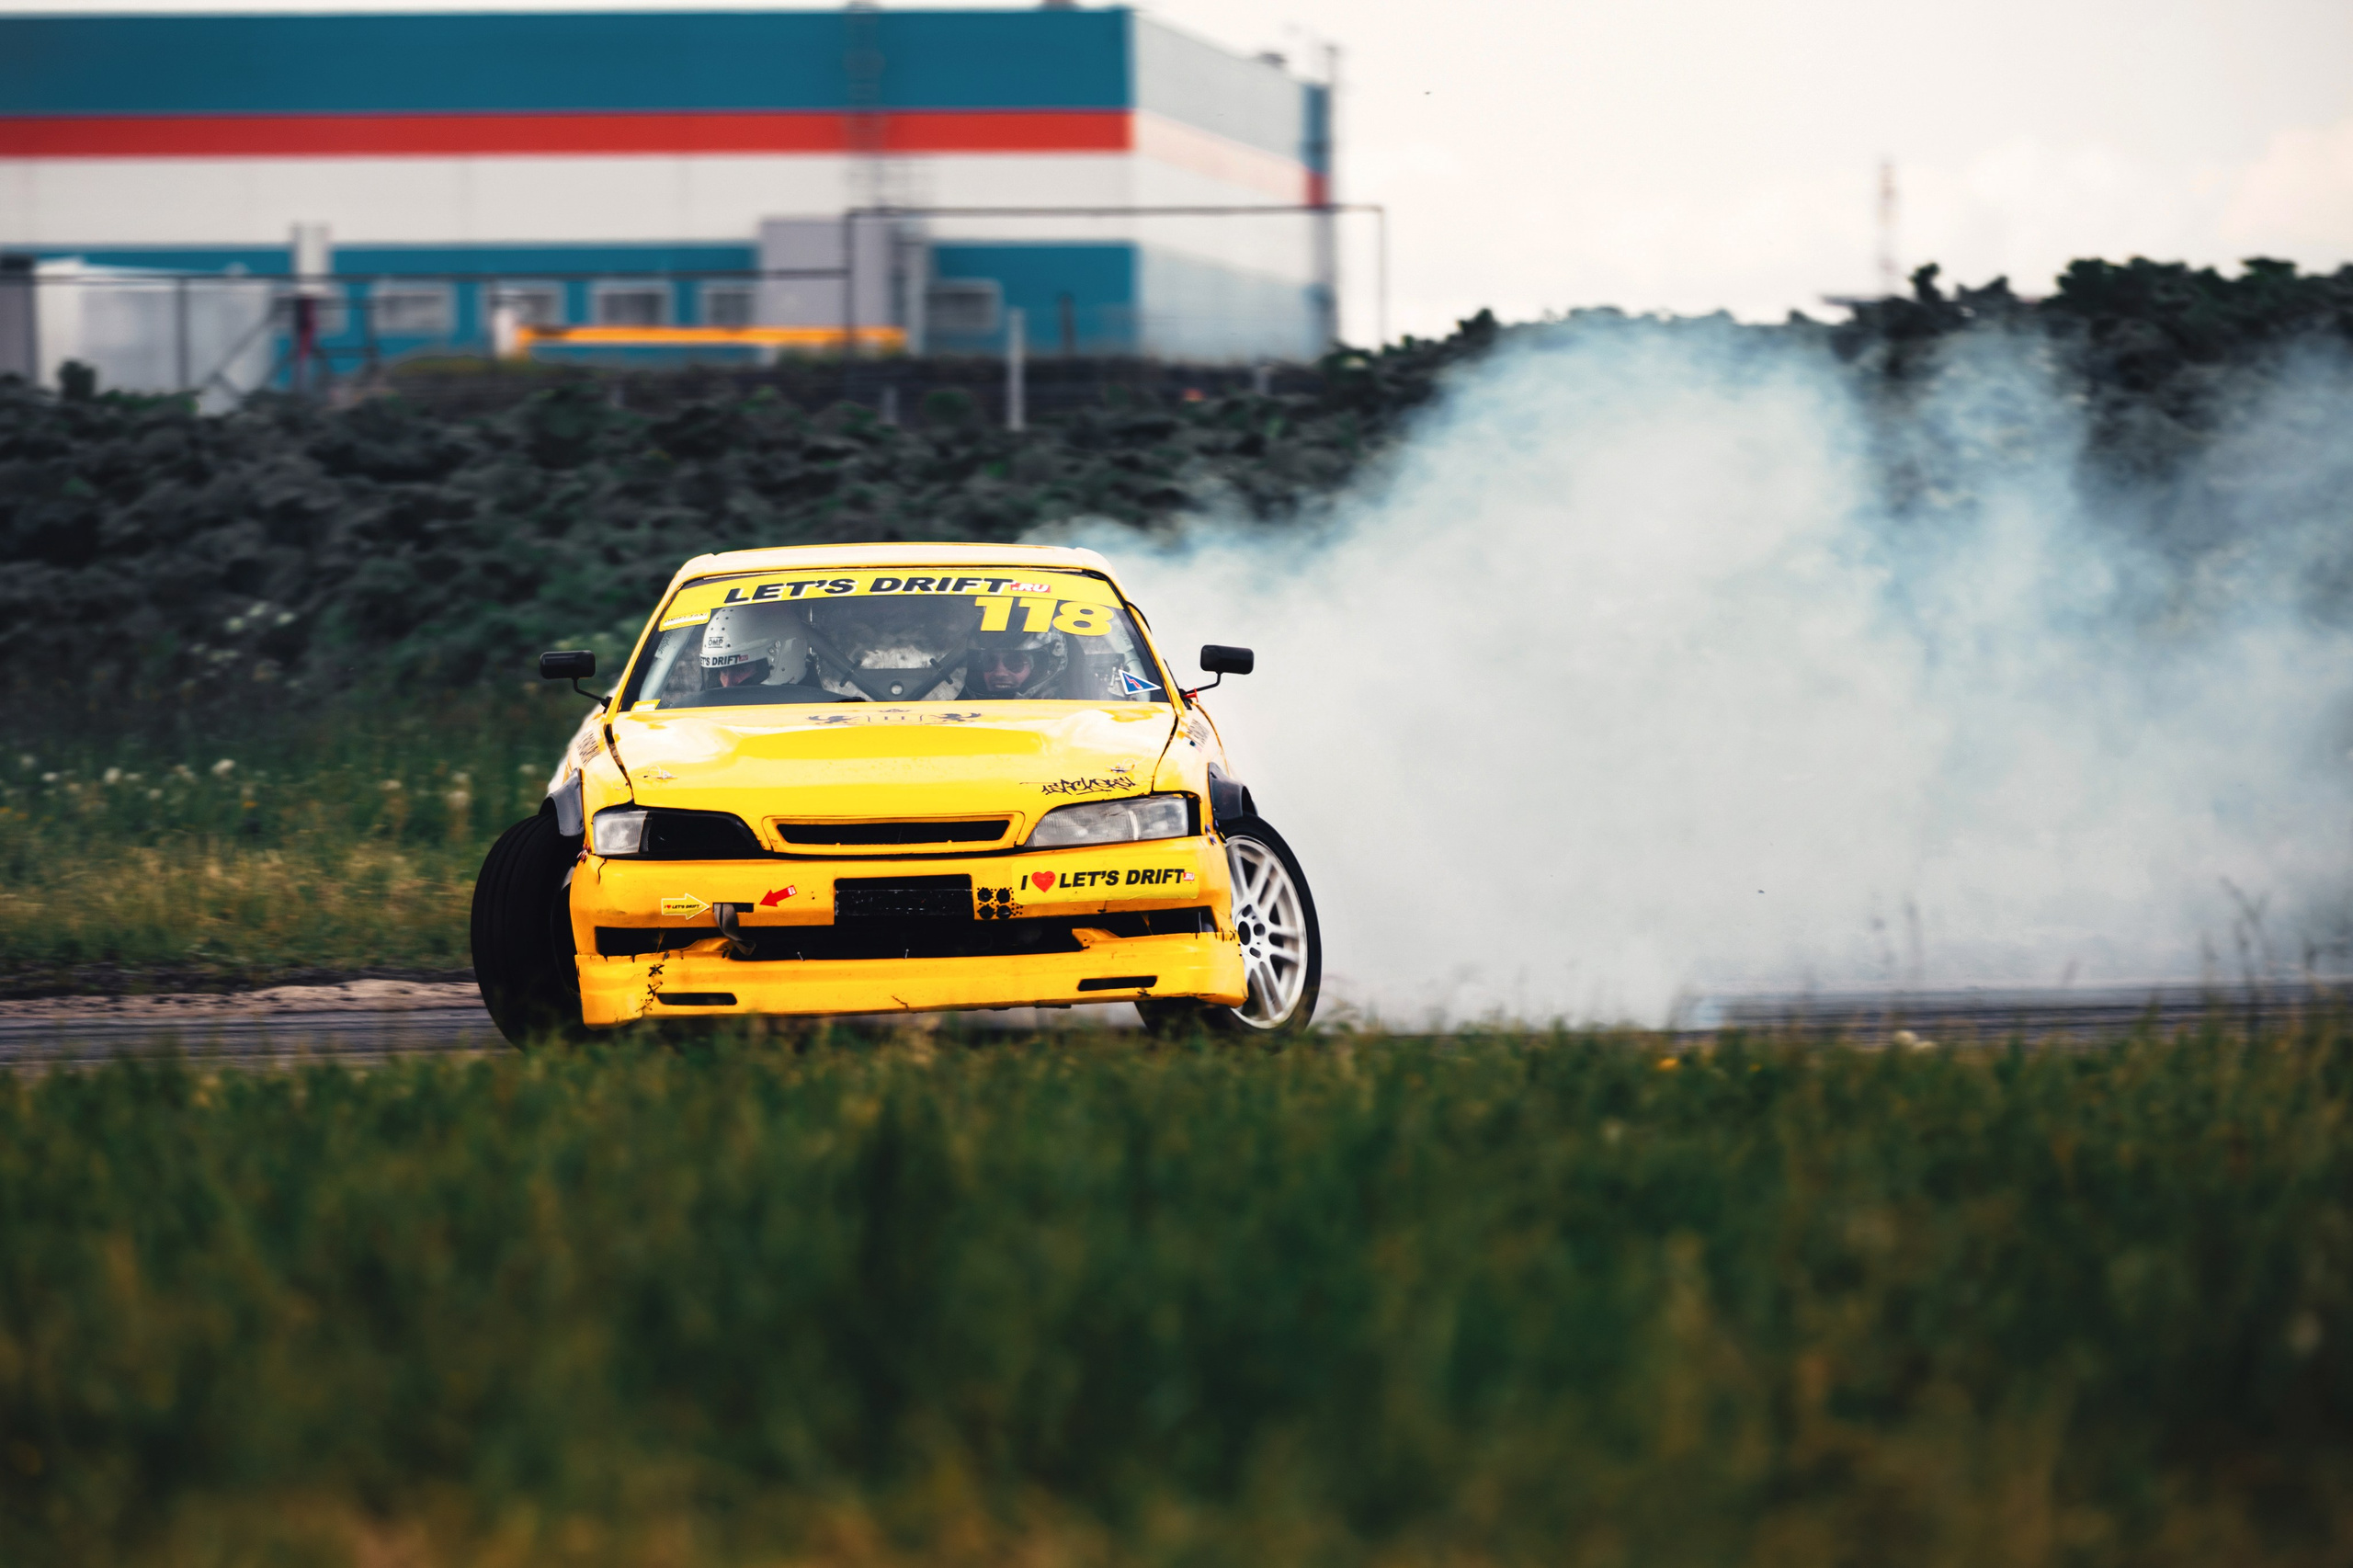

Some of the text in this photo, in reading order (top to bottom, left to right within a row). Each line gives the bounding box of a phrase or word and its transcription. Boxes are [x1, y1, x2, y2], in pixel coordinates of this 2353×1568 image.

[723, 578, 857, 604] LET'S
[974, 596, 1115, 637] 118
[708, 638, 724, 646] OMP
[1020, 875, 1029, 891] I
[1059, 869, 1120, 889] LET'S
